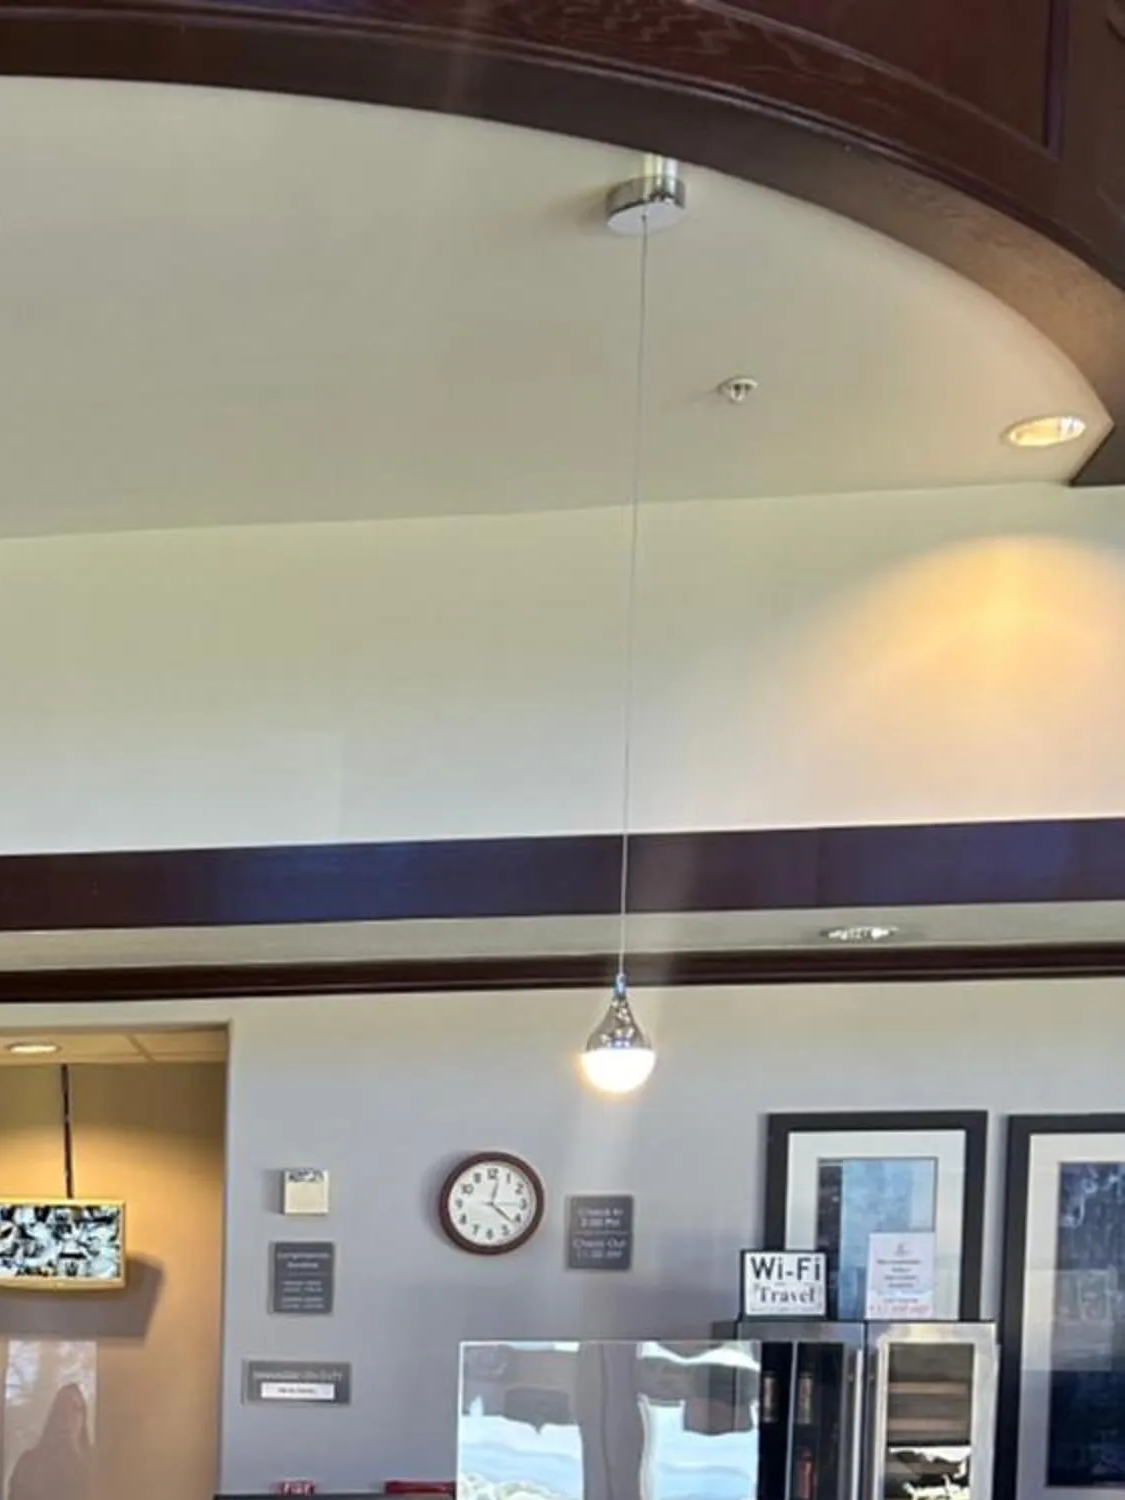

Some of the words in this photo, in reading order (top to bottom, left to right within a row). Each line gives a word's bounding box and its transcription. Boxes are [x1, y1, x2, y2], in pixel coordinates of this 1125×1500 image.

[486, 1167, 499, 1180] 12
[461, 1183, 475, 1195] 10
[515, 1182, 524, 1195] 2
[519, 1198, 528, 1211] 3
[472, 1223, 480, 1236] 7
[486, 1228, 494, 1240] 6
[750, 1256, 821, 1281] Wi-Fi
[759, 1286, 815, 1303] Travel
